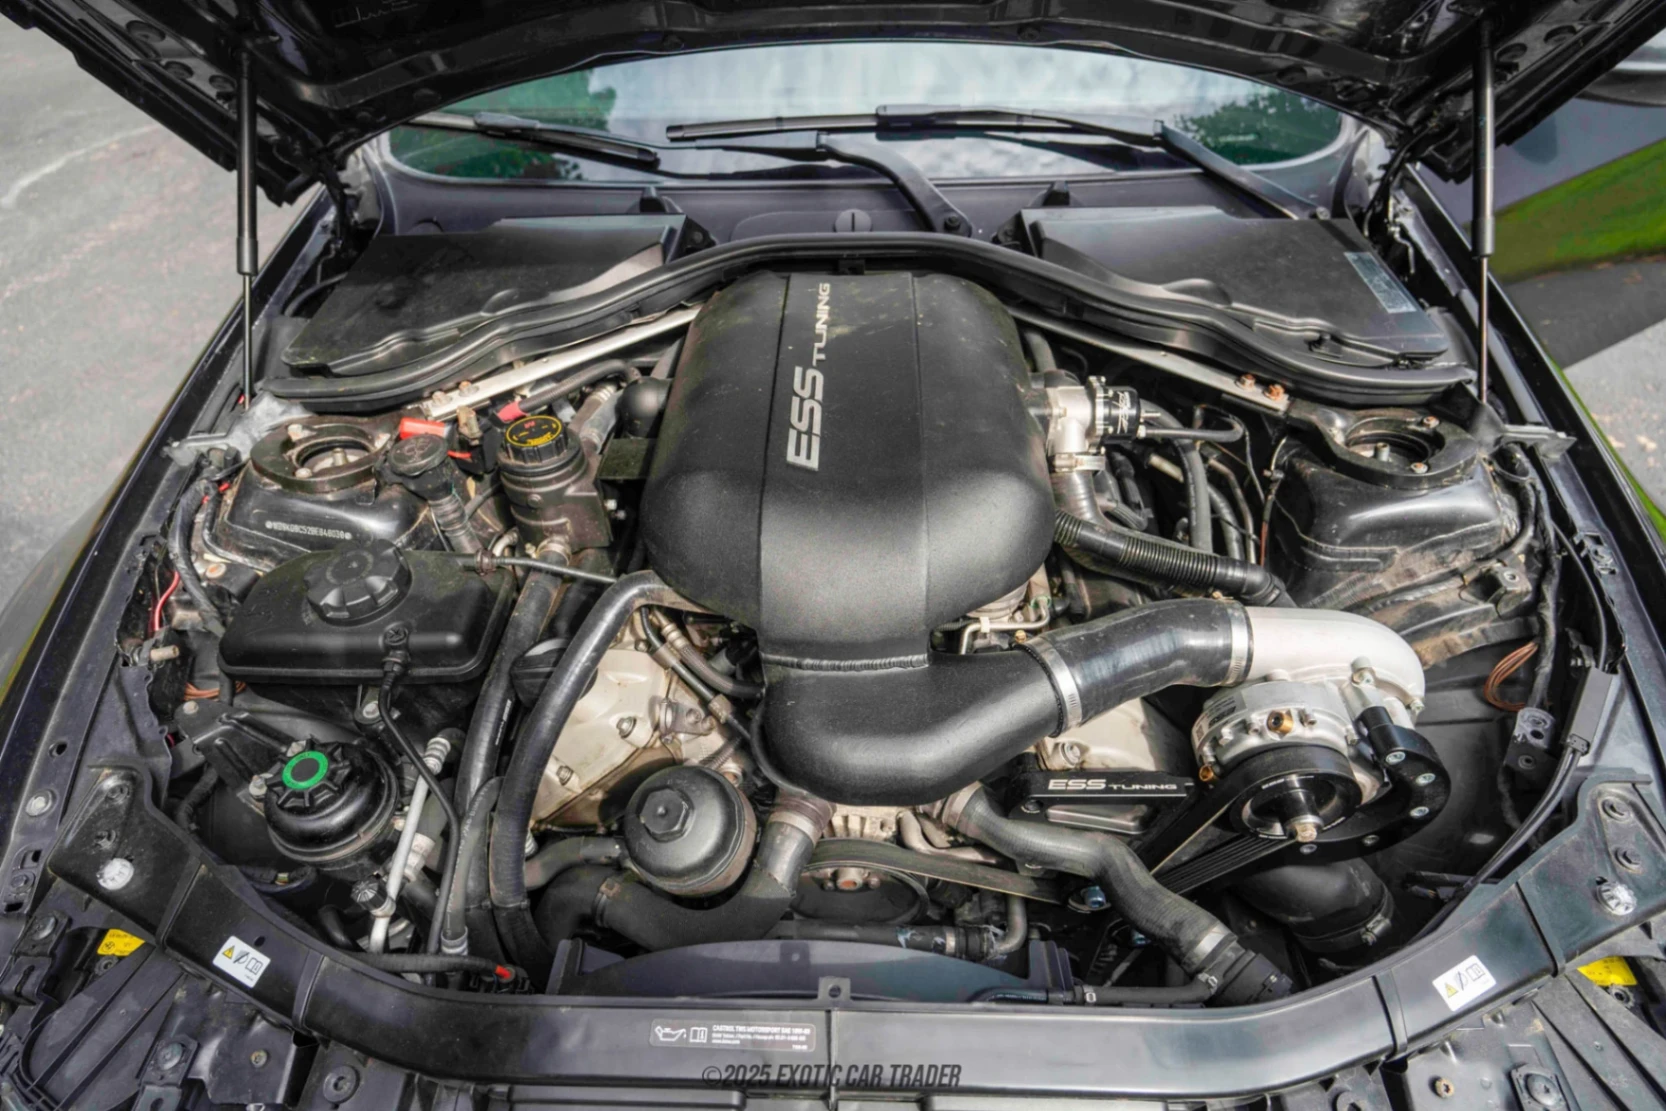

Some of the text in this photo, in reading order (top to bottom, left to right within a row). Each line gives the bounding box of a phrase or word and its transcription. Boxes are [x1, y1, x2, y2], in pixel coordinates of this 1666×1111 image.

[786, 282, 831, 471] ESS TUNING
[1048, 779, 1107, 790] ESS
